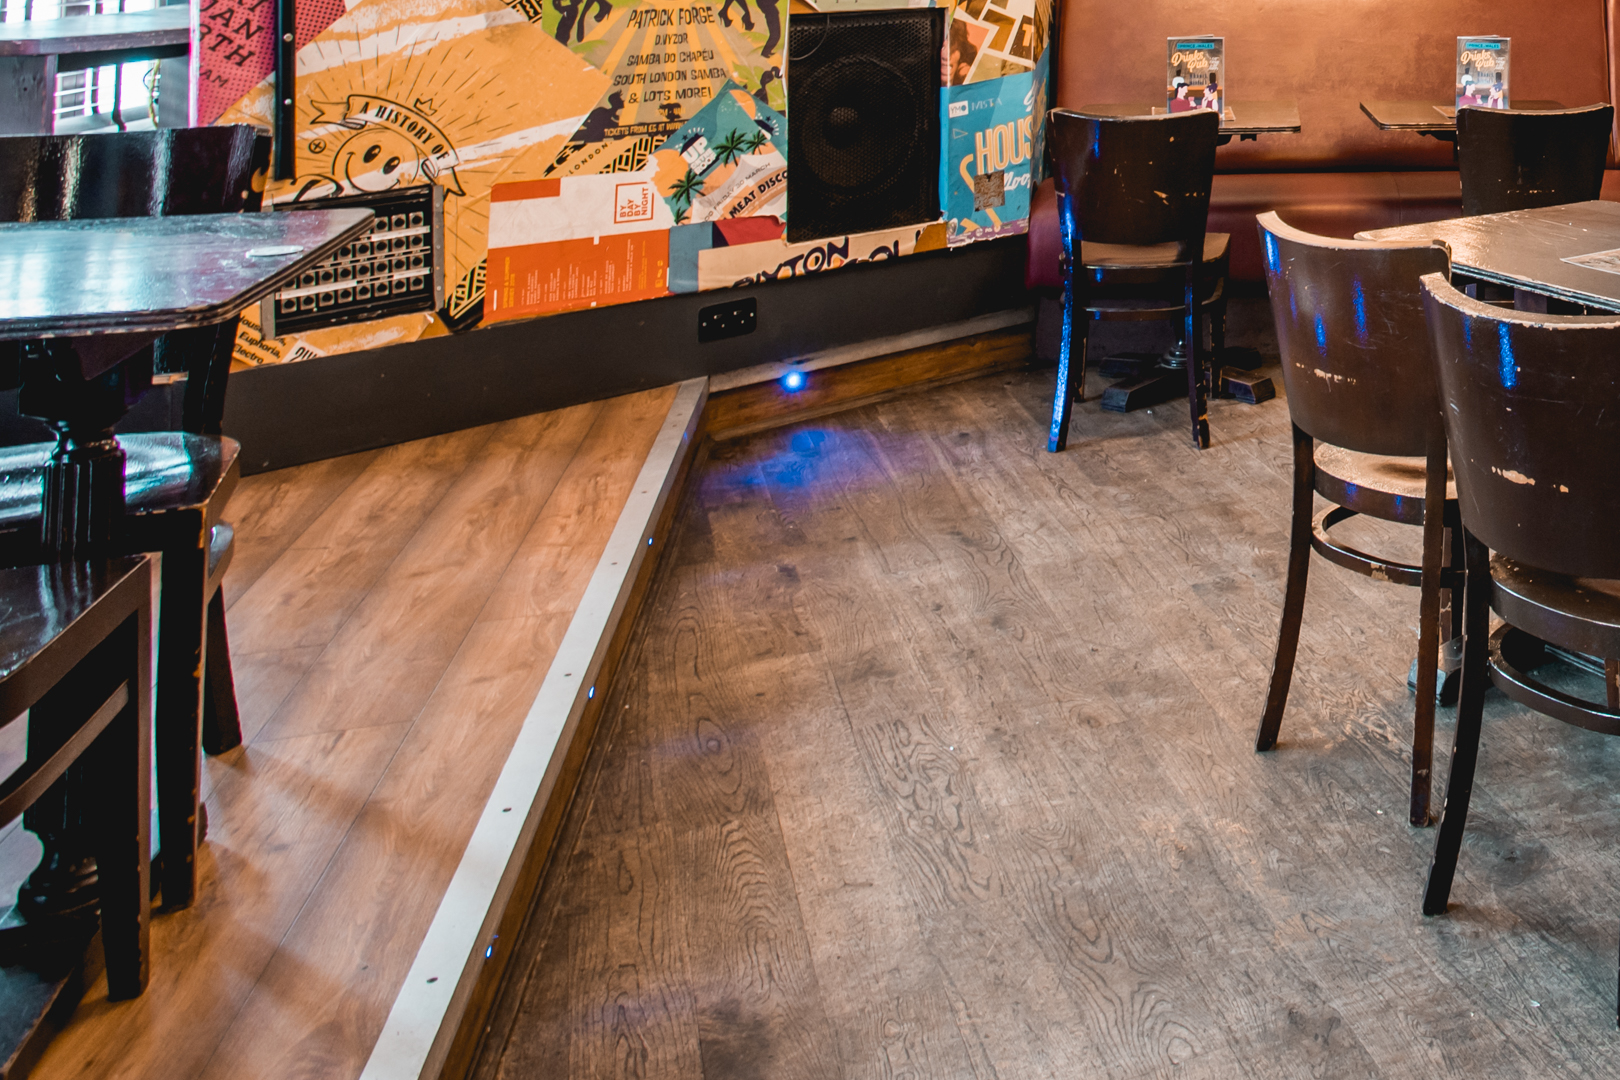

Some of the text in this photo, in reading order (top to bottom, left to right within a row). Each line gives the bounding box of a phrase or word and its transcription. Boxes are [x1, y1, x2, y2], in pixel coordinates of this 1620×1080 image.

[626, 6, 716, 29] PATRICK FORGE
[626, 53, 661, 67] SAMBA
[663, 52, 676, 63] DO
[1171, 49, 1204, 67] Drinks
[1187, 58, 1209, 73] Pub
[1460, 49, 1491, 65] Drinks
[1475, 58, 1495, 71] Pub
[613, 67, 727, 86] SOUTH LONDON SAMBA
[628, 86, 712, 104] & LOTS MORE!
[359, 101, 450, 161] A HISTORY OF
[604, 127, 629, 137] TICKETS
[630, 125, 647, 133] FROM
[569, 142, 609, 175] LONDON
[682, 136, 708, 163] UP
[745, 162, 771, 180] MARCH
[626, 199, 634, 217] DAY
[633, 203, 641, 216] BY
[641, 187, 649, 215] NIGHT
[729, 191, 757, 219] MEAT
[619, 205, 627, 218] BY
[238, 331, 281, 359] Euphoria,
